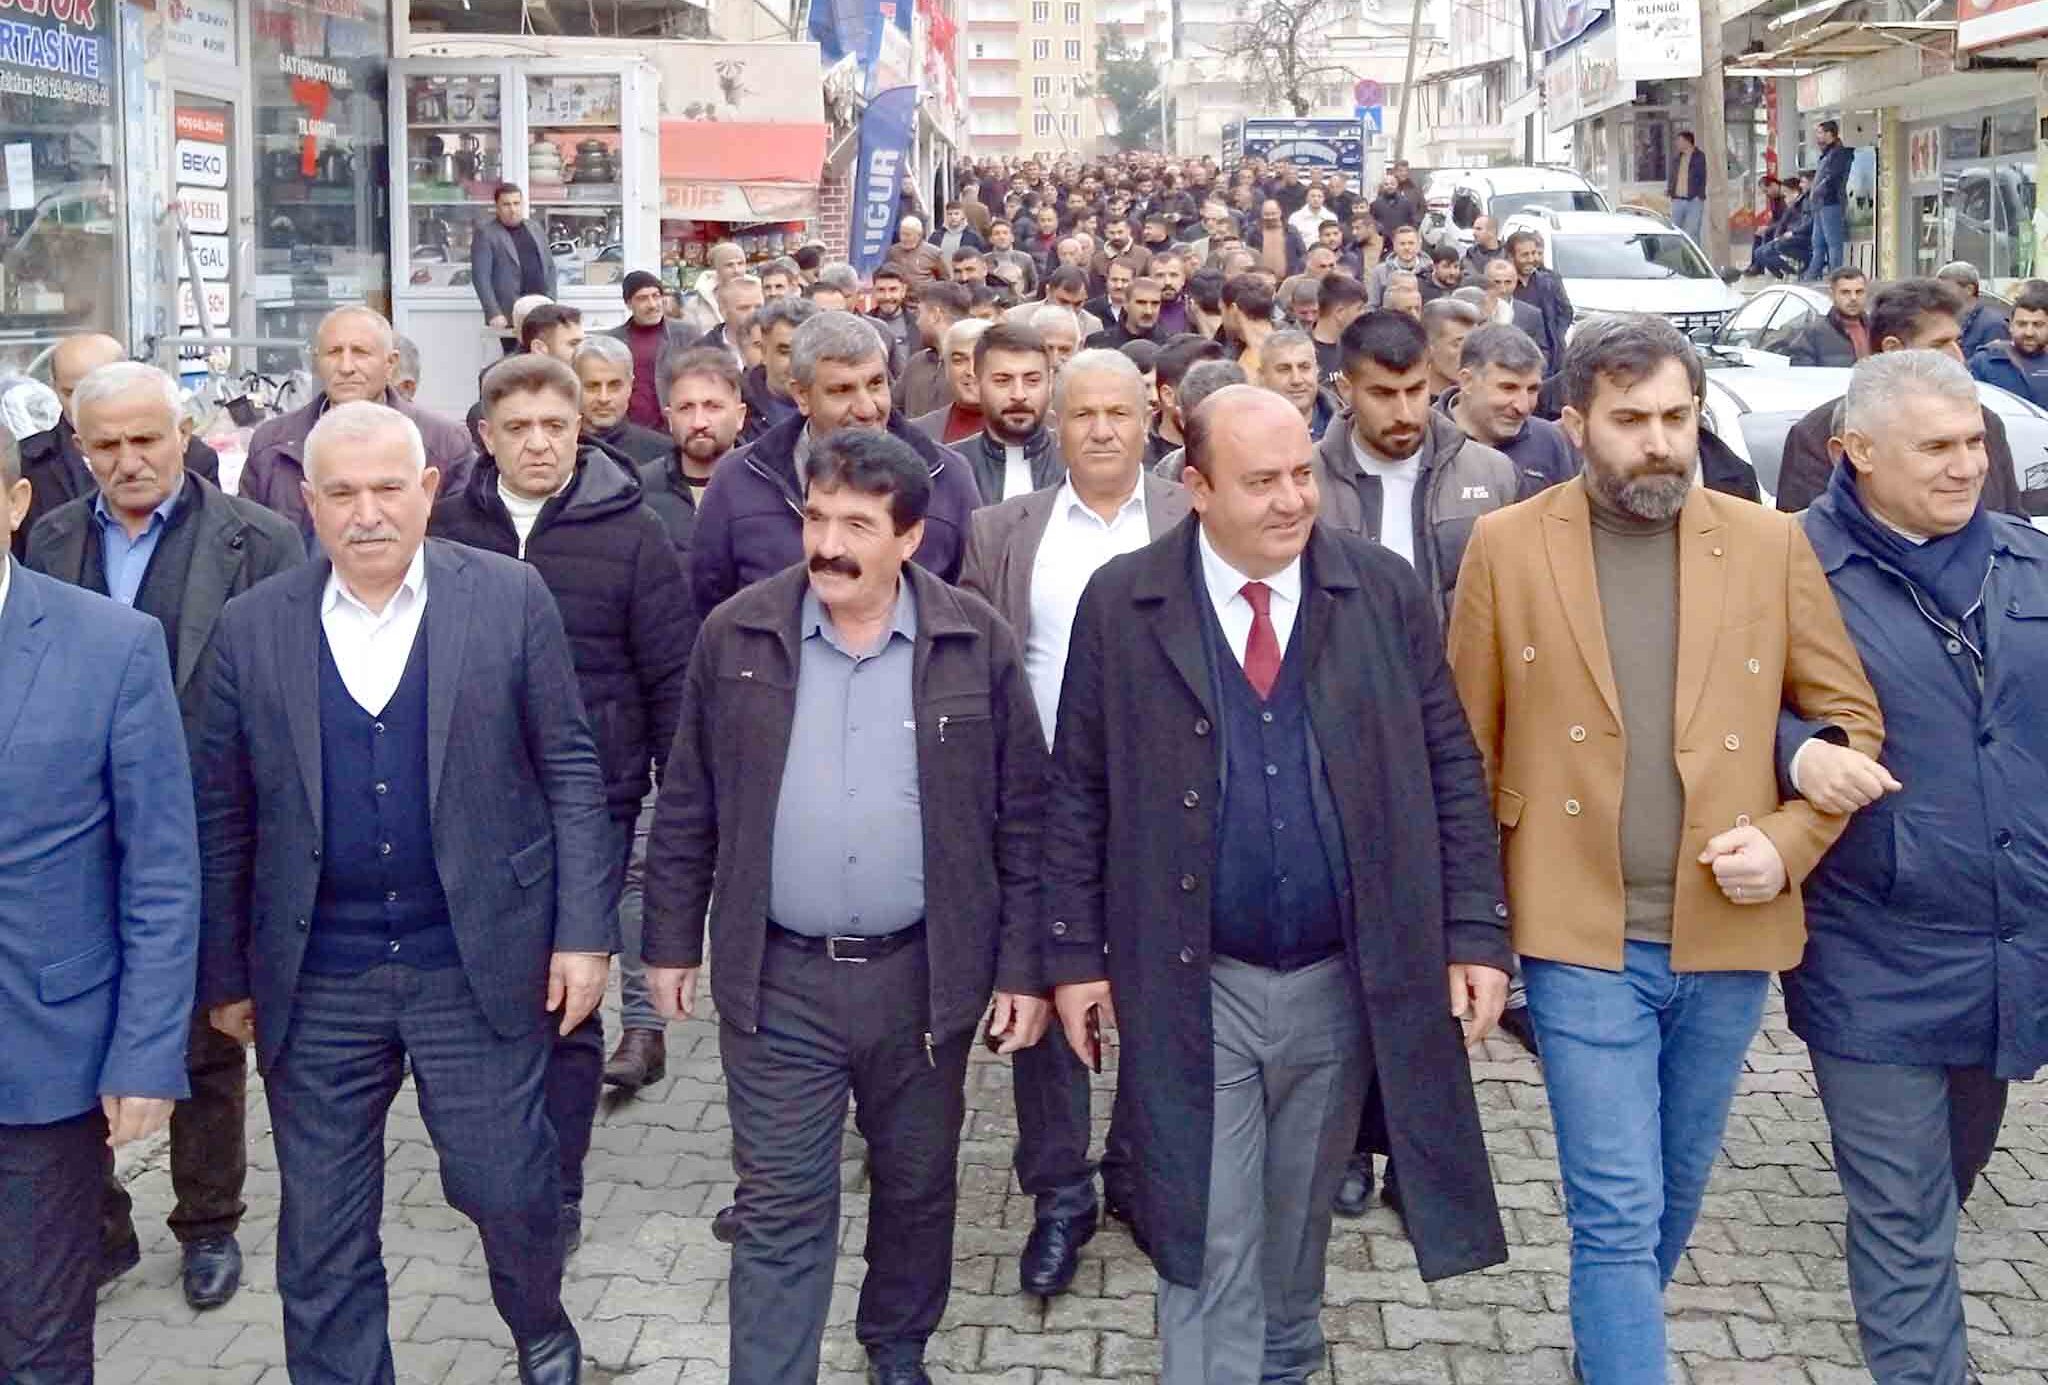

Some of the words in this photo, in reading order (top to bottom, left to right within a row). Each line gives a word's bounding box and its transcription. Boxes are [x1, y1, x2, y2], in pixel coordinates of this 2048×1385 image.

[182, 152, 221, 175] BEKO
[181, 200, 222, 220] VESTEL
[182, 246, 225, 267] GAL
